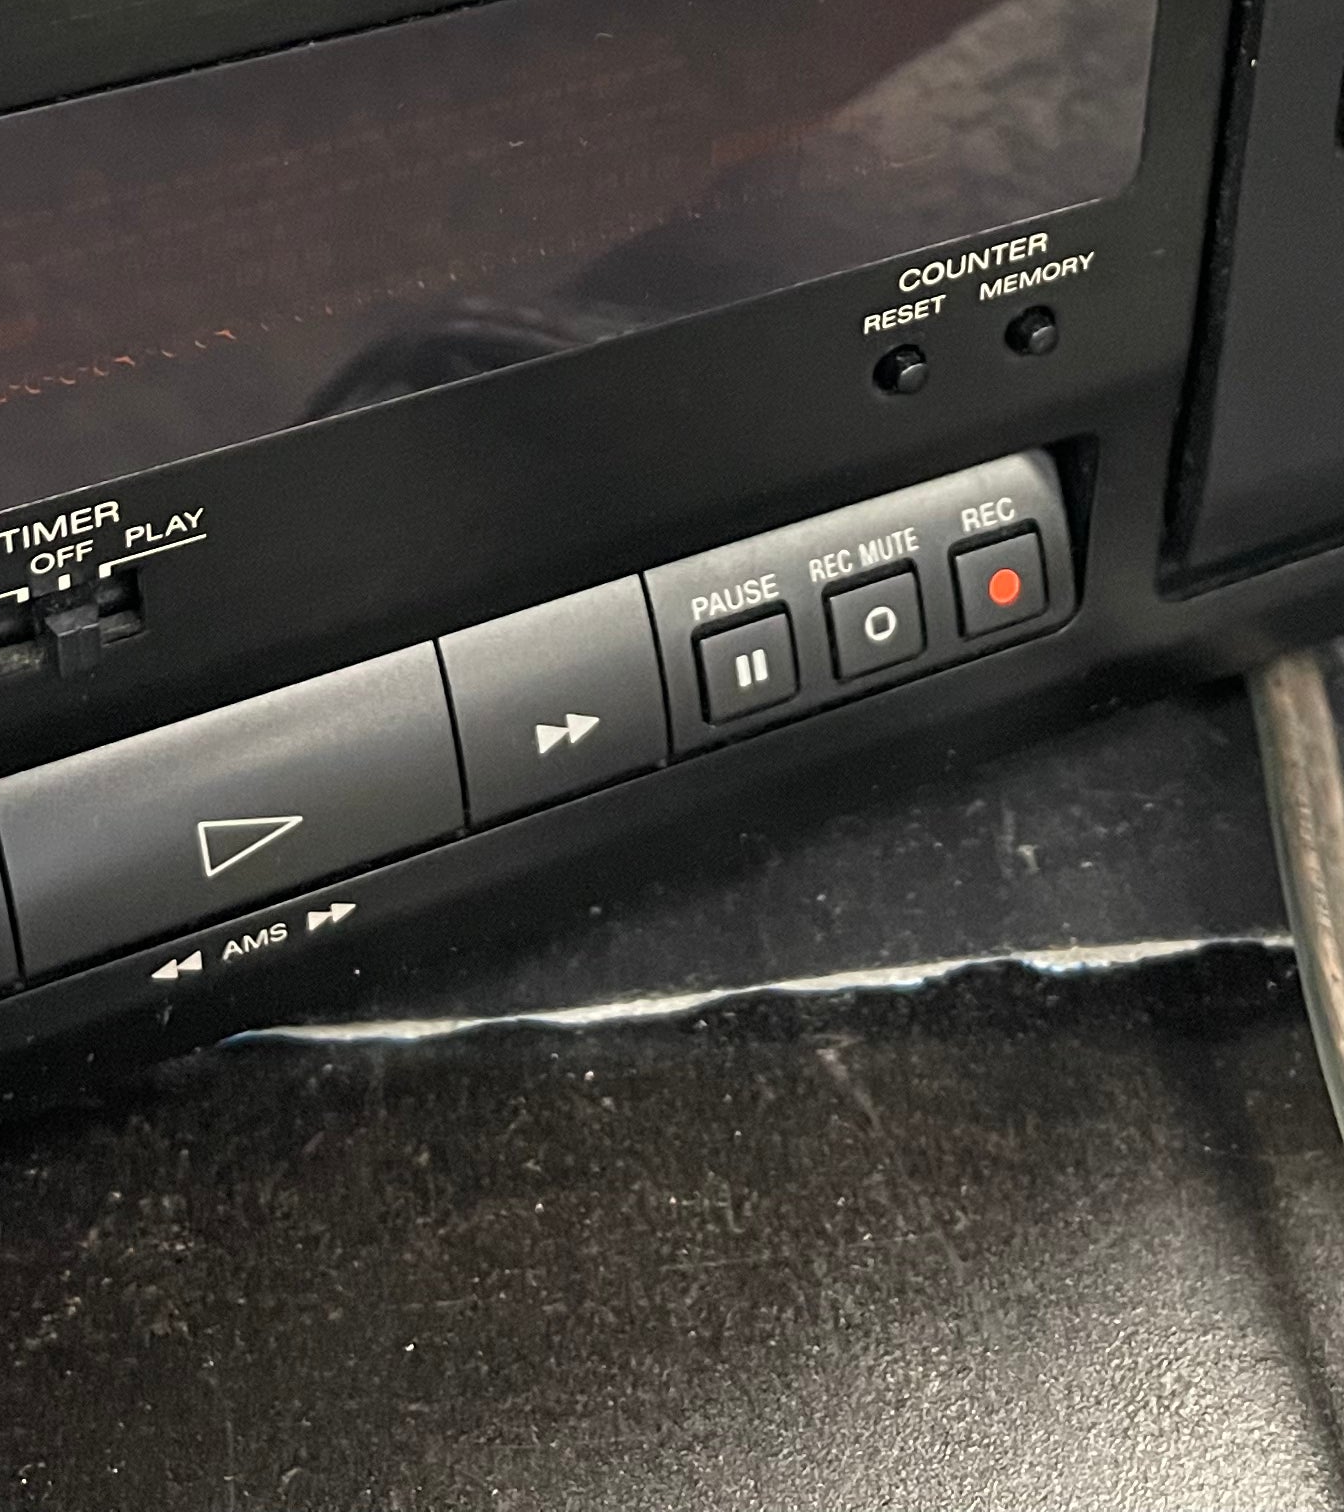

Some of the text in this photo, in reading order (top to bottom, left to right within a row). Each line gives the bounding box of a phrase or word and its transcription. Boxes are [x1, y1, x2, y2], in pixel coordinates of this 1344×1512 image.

[898, 232, 1049, 292] COUNTER
[862, 251, 1096, 335] RESET MEMORY
[29, 539, 94, 575] OFF
[124, 507, 205, 549] PLAY
[960, 496, 1018, 533] REC
[808, 526, 921, 584] REC MUTE
[690, 572, 780, 622] PAUSE
[221, 922, 289, 961] AMS
